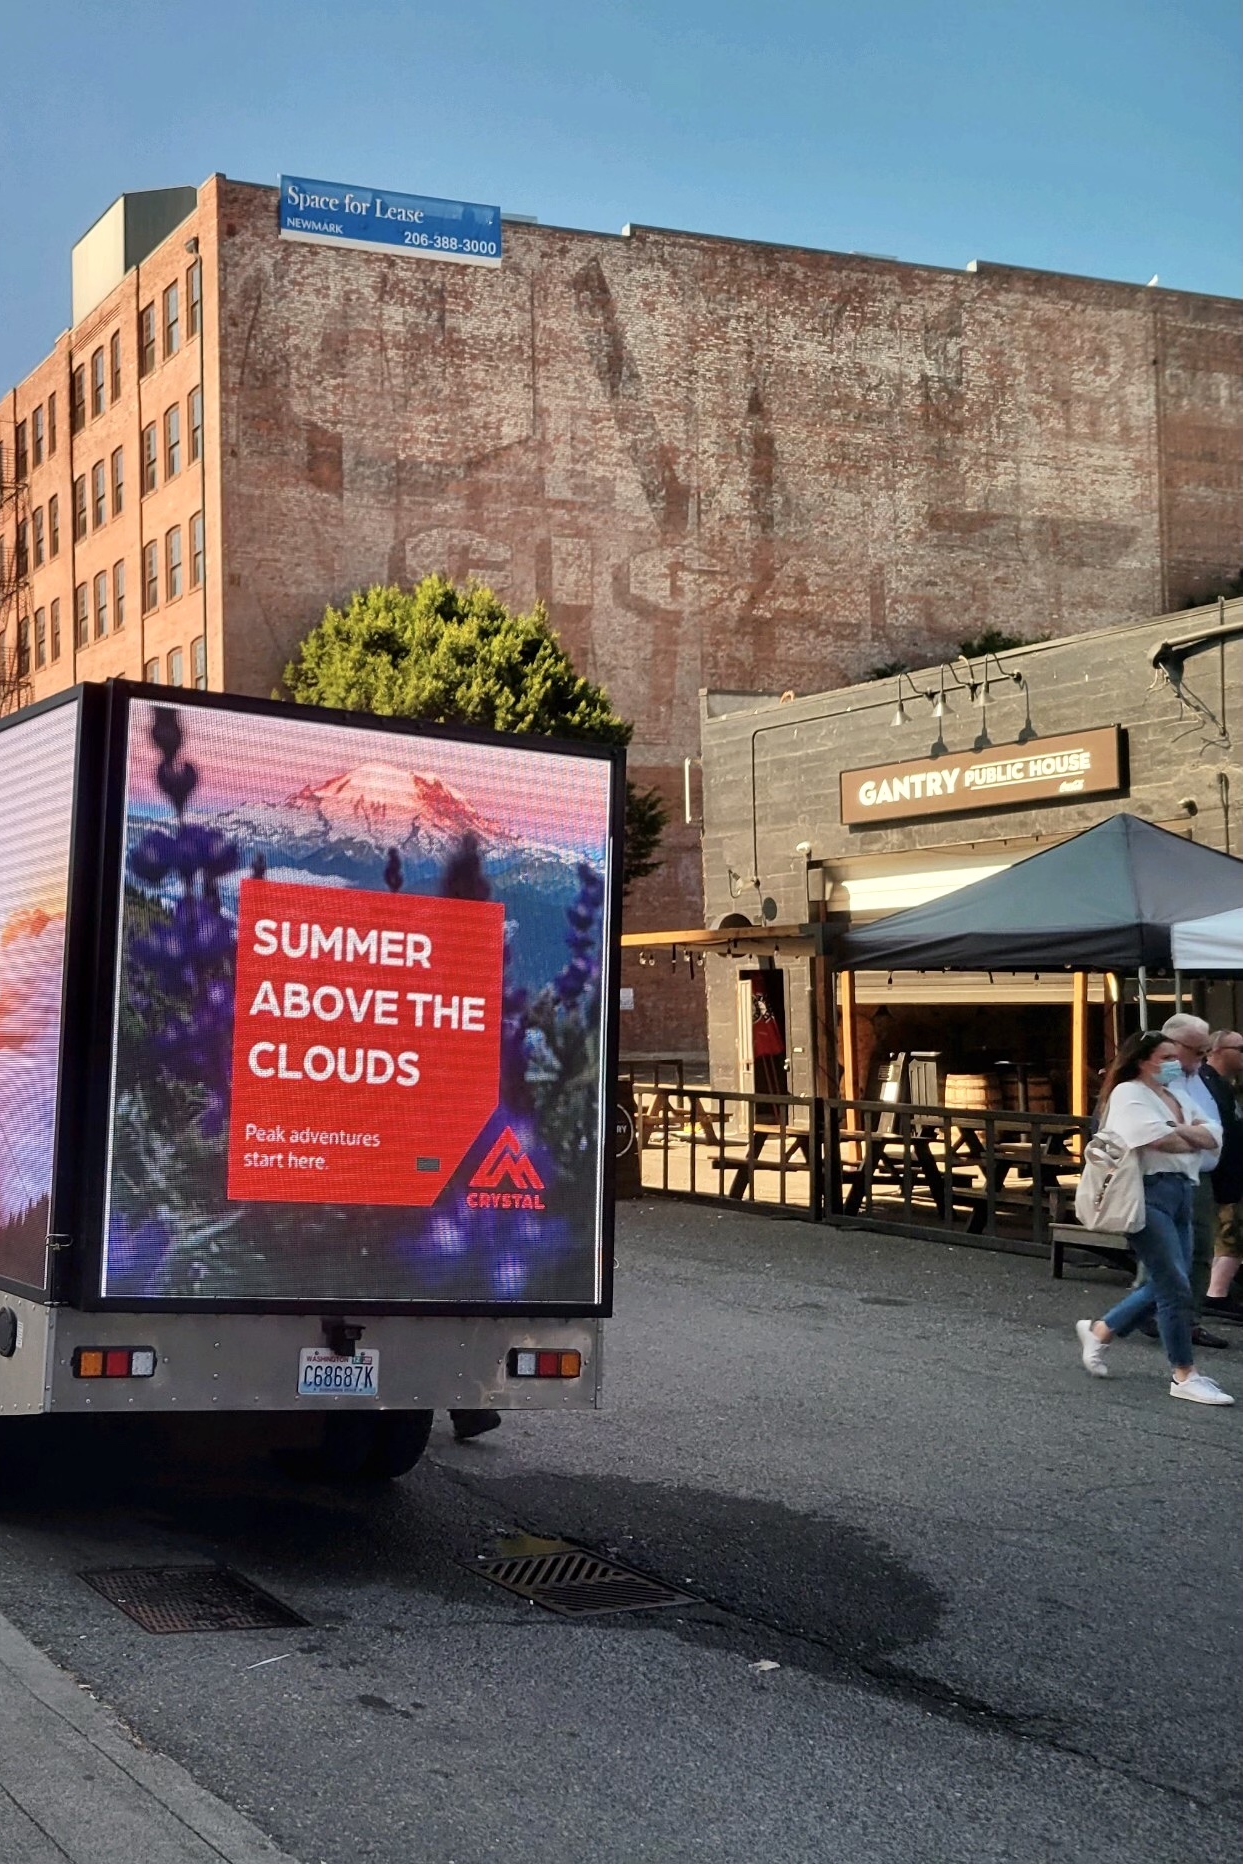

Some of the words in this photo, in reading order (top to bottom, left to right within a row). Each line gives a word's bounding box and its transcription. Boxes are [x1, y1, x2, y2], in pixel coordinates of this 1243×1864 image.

[287, 185, 339, 211] Space
[344, 193, 371, 215] for
[375, 198, 425, 224] Lease
[286, 216, 344, 234] NEWMARK
[404, 231, 497, 256] 206-388-3000
[858, 767, 960, 806] GANTRY
[964, 764, 1025, 788] PUBLIC
[1029, 751, 1091, 778] HOUSE
[253, 919, 432, 969] SUMMER
[249, 980, 399, 1026] ABOVE
[405, 992, 486, 1031] THE
[248, 1042, 421, 1087] CLOUDS
[245, 1123, 286, 1143] Peak
[289, 1127, 381, 1148] adventures
[243, 1152, 284, 1168] start
[288, 1152, 330, 1170] here.
[466, 1192, 546, 1210] CRYSTAL
[304, 1365, 374, 1388] C68687K
